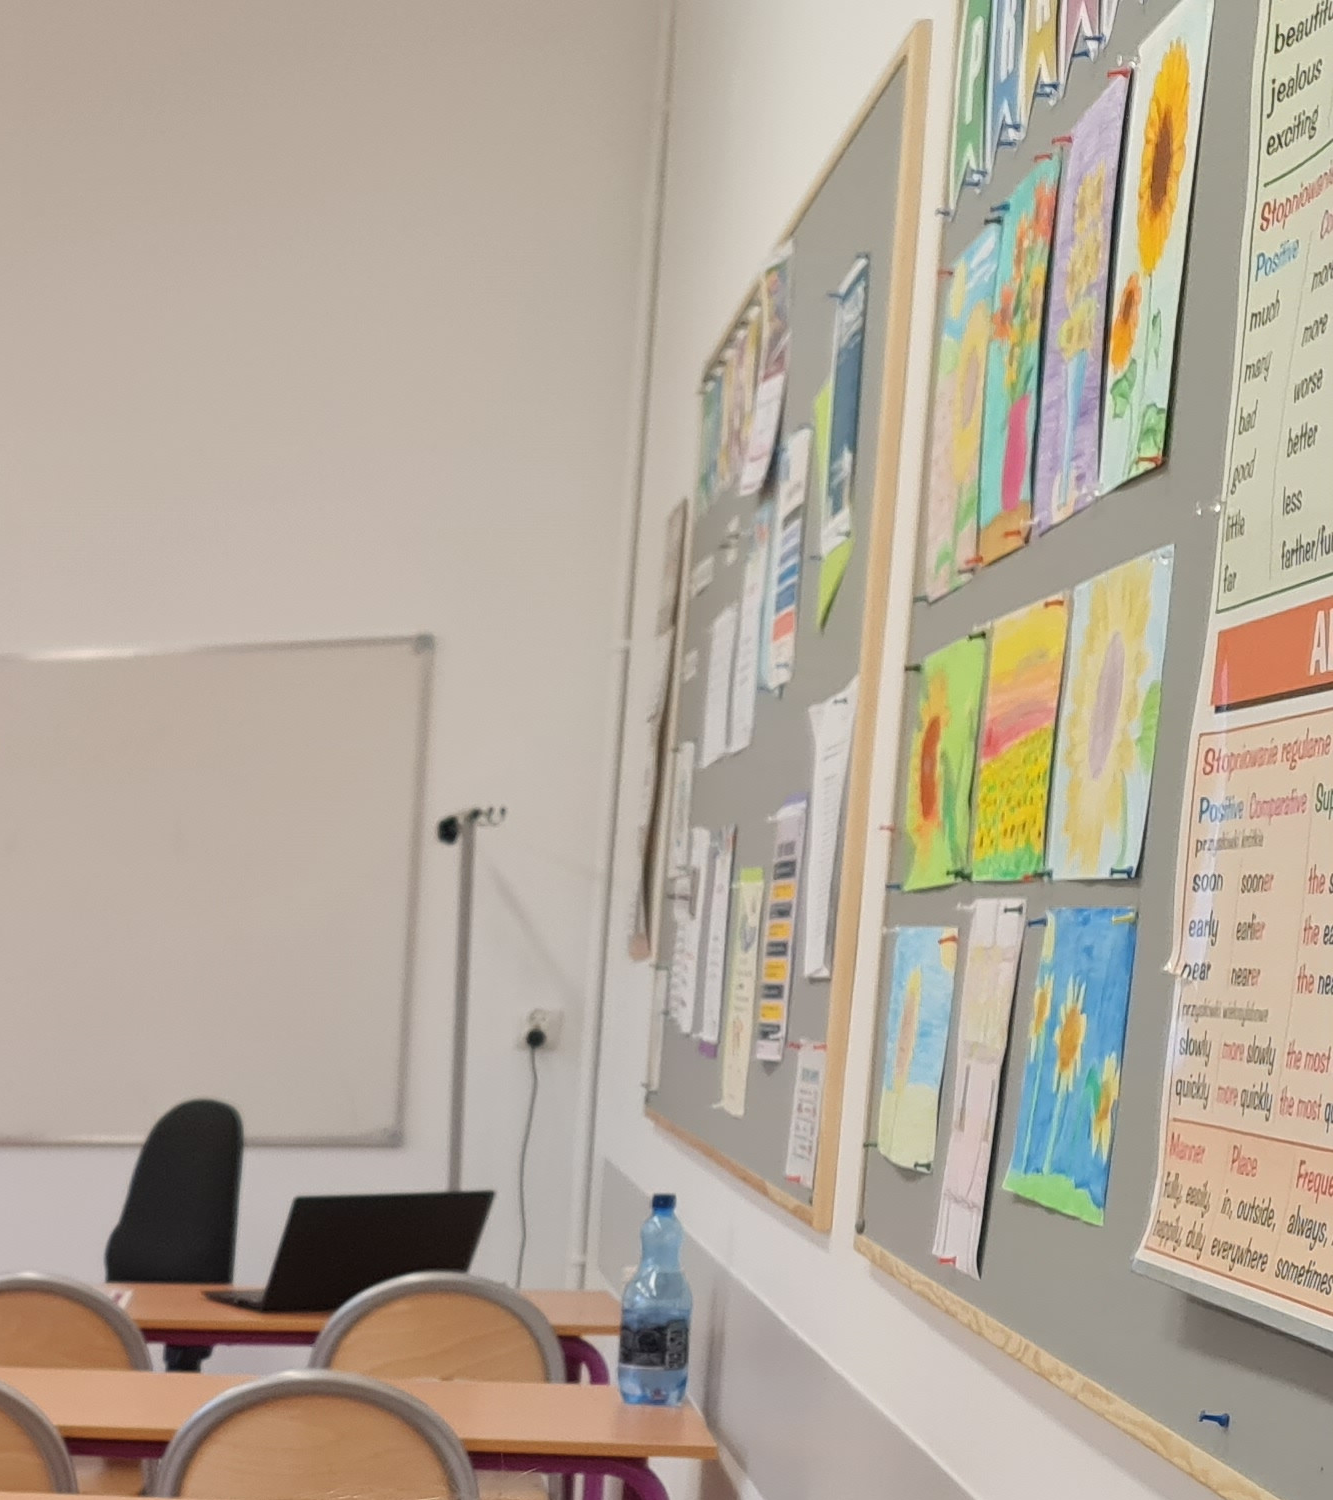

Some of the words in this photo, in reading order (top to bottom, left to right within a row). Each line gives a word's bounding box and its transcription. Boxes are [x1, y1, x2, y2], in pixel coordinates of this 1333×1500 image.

[1267, 58, 1322, 119] jealous
[1266, 104, 1319, 156] exciting
[1254, 239, 1300, 283] Positive
[1249, 289, 1280, 332] much
[1243, 350, 1273, 383] many
[1301, 312, 1328, 347] more
[1238, 399, 1259, 436] bad
[1293, 368, 1323, 404] worse
[1230, 447, 1257, 496] good
[1286, 422, 1318, 458] better
[1225, 513, 1245, 543] little
[1282, 486, 1303, 517] less
[1222, 563, 1237, 594] far
[1281, 727, 1331, 771] regularne
[1198, 795, 1244, 824] Positive
[1249, 788, 1307, 826] Comparative
[1192, 873, 1223, 893] soon
[1240, 872, 1274, 894] sooner
[1308, 864, 1326, 895] the
[1188, 910, 1219, 946] early
[1236, 912, 1266, 941] earlier
[1303, 915, 1320, 945] the
[1231, 967, 1261, 987] nearer
[1296, 963, 1314, 994] the
[1179, 1028, 1211, 1067] slowly
[1222, 1041, 1244, 1061] more
[1246, 1035, 1276, 1076] slowly
[1285, 1038, 1302, 1070] the
[1304, 1046, 1331, 1073] most
[1175, 1072, 1210, 1110] quickly
[1217, 1084, 1238, 1106] more
[1240, 1081, 1273, 1122] quickly
[1279, 1085, 1294, 1117] the
[1296, 1094, 1322, 1120] most
[1231, 1145, 1258, 1177] Place
[1237, 1196, 1277, 1232] outside,
[1287, 1204, 1328, 1251] always,
[1210, 1237, 1269, 1272] everywhere
